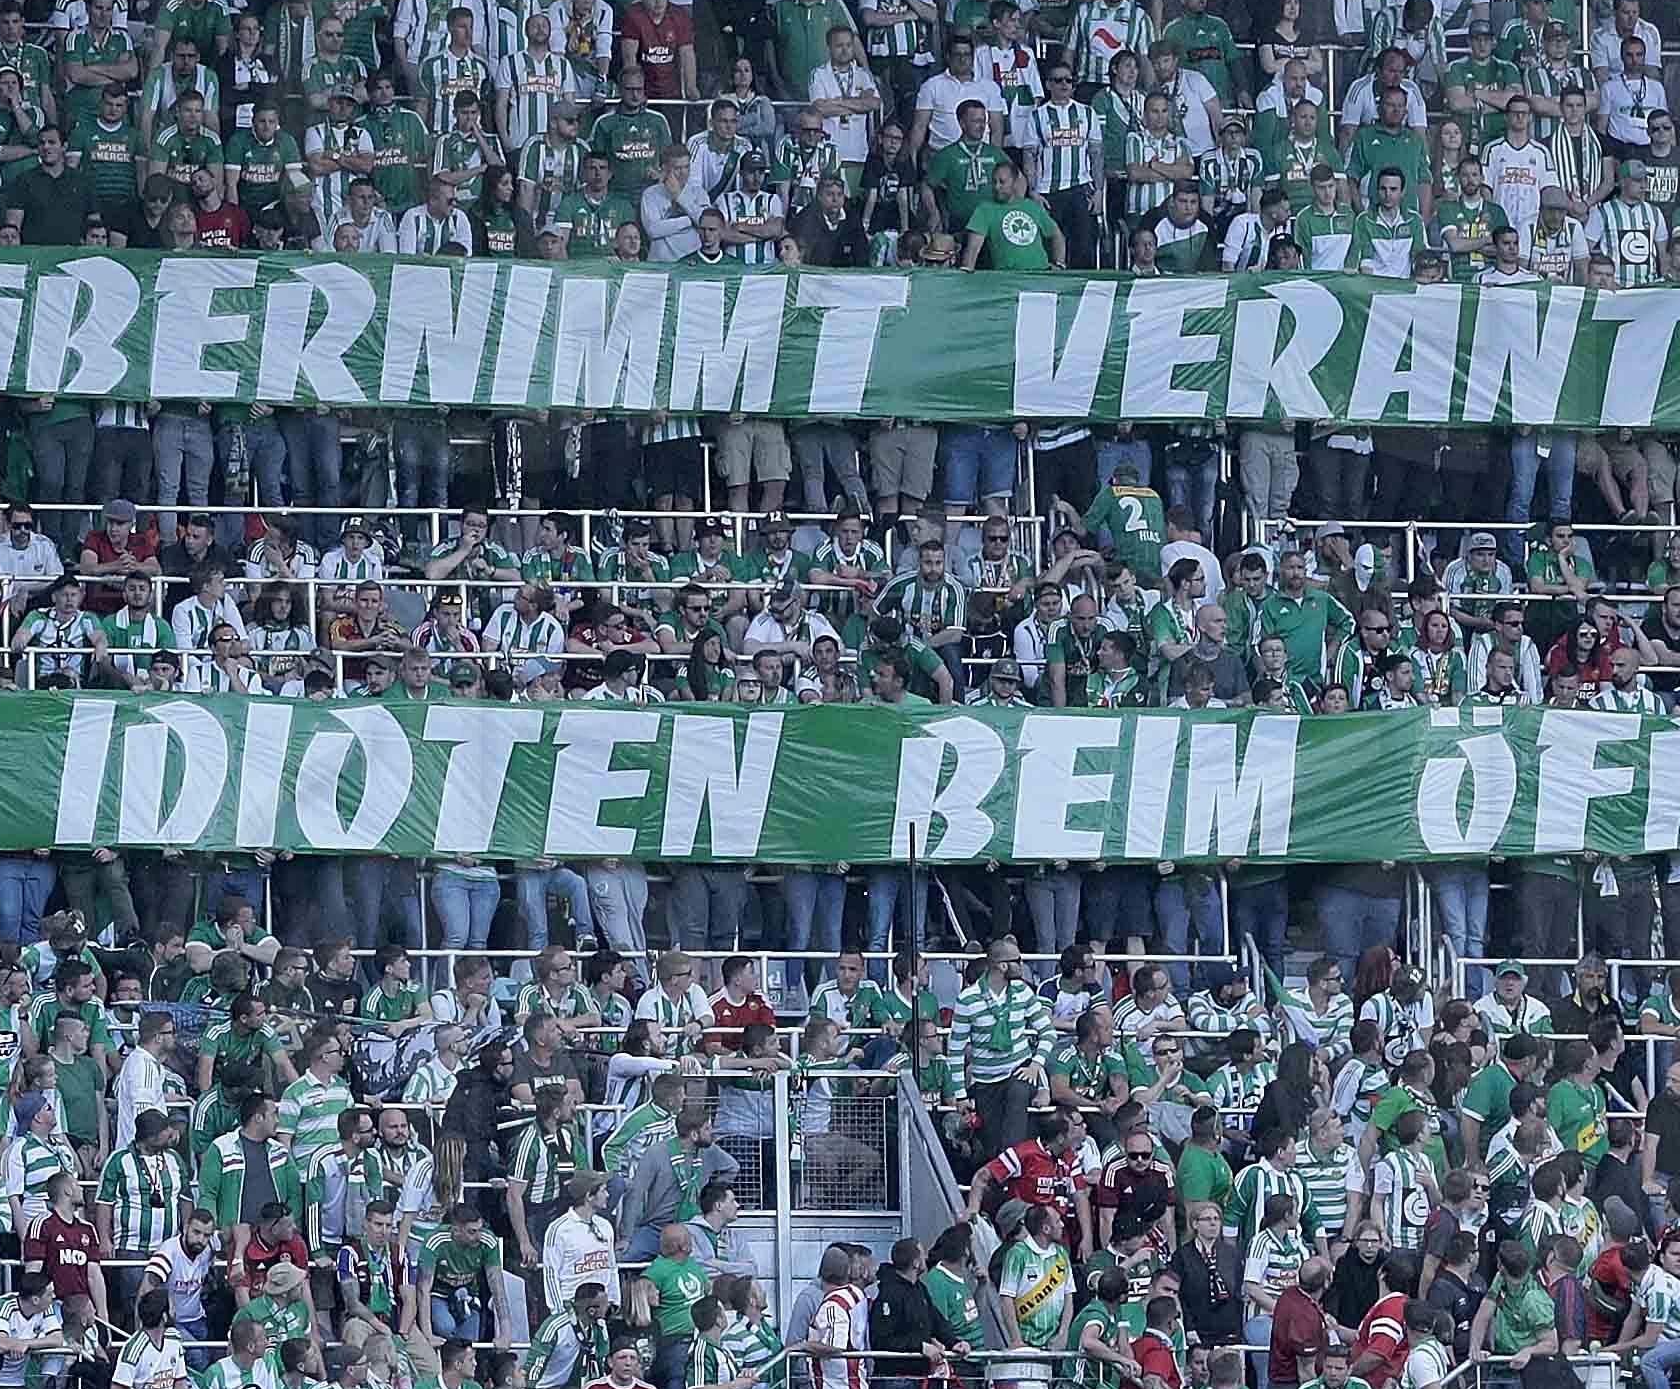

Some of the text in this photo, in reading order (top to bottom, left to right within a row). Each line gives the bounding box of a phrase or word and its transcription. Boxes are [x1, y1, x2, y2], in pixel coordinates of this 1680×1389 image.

[98, 144, 127, 152] WIEN
[249, 164, 274, 172] WIEN
[1121, 497, 1148, 531] 2
[54, 698, 784, 858] IDIOTEN
[892, 714, 1301, 860] BEIM
